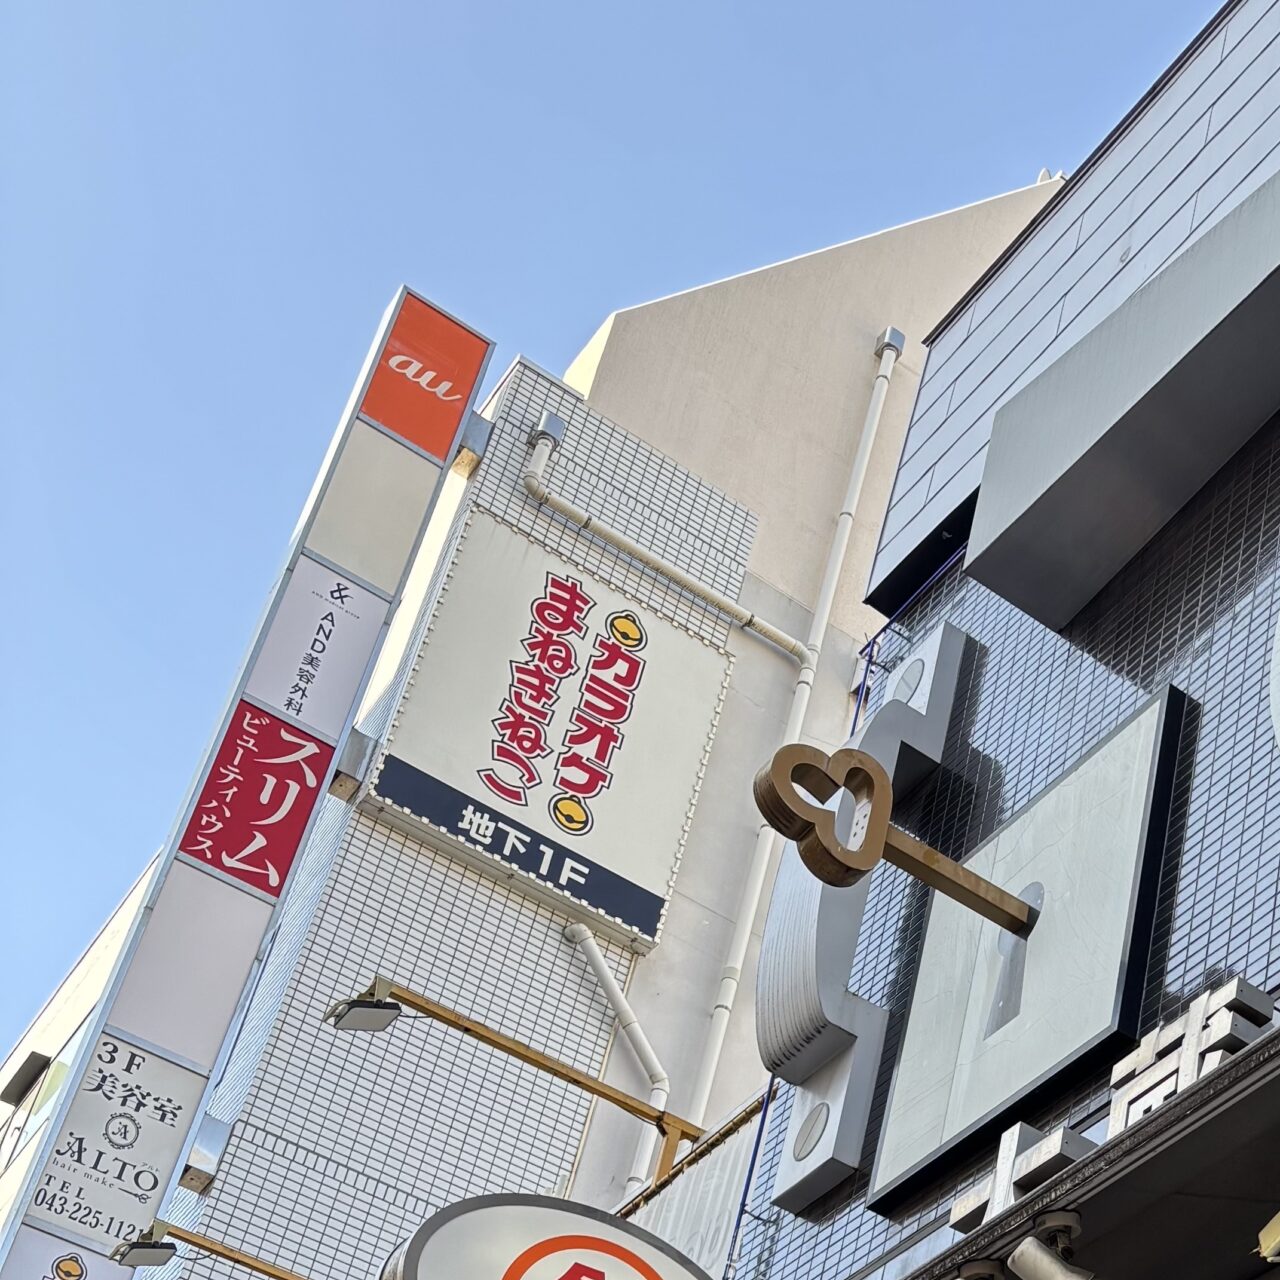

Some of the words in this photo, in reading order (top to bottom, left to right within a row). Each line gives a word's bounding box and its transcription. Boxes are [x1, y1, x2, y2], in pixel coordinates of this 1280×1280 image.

[388, 354, 462, 401] au
[284, 611, 335, 716] AND美容外科
[477, 571, 597, 806] まねきねこ
[554, 634, 645, 798] カラオケ
[186, 712, 270, 859] ビューティハウス
[221, 728, 320, 887] スリム
[457, 805, 590, 886] 地下1F
[97, 1041, 146, 1075] 3F
[82, 1067, 183, 1129] 美容室
[44, 1174, 86, 1200] TEL
[52, 1158, 78, 1174] hair
[83, 1171, 115, 1189] make
[55, 1131, 159, 1193] ALTO
